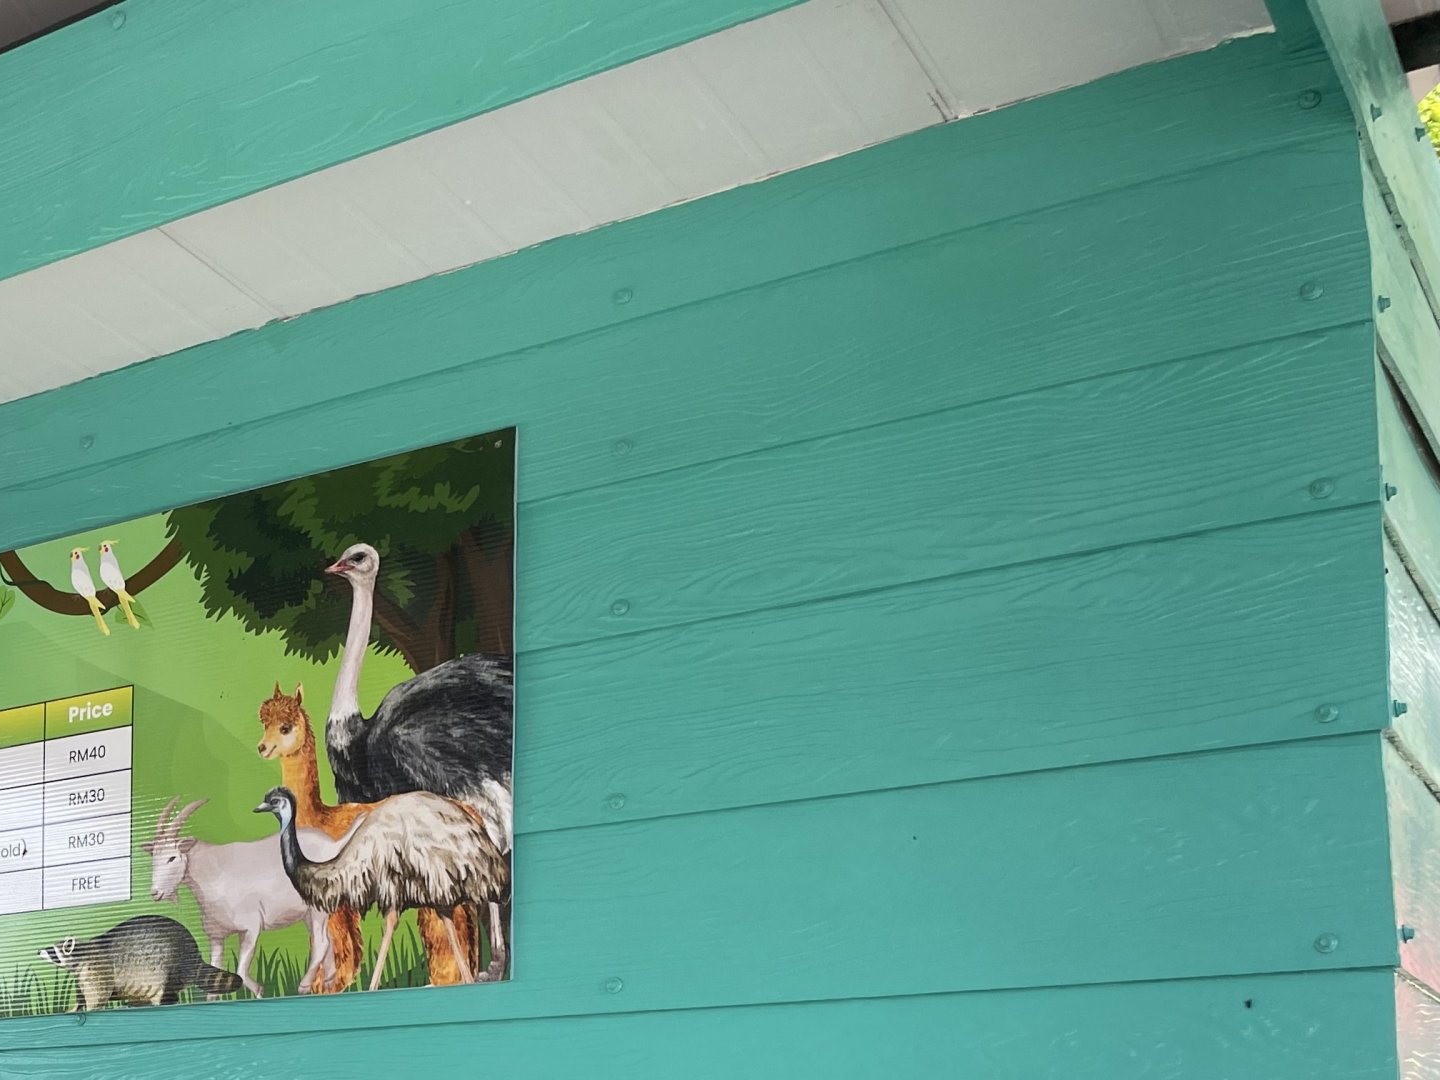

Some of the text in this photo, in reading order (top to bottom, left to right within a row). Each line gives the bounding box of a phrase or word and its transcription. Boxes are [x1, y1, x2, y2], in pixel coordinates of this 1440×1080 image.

[68, 701, 113, 724] Price
[69, 745, 106, 764] RM40
[68, 788, 105, 806] RM30
[68, 832, 105, 849] RM30
[71, 875, 101, 891] FREE
